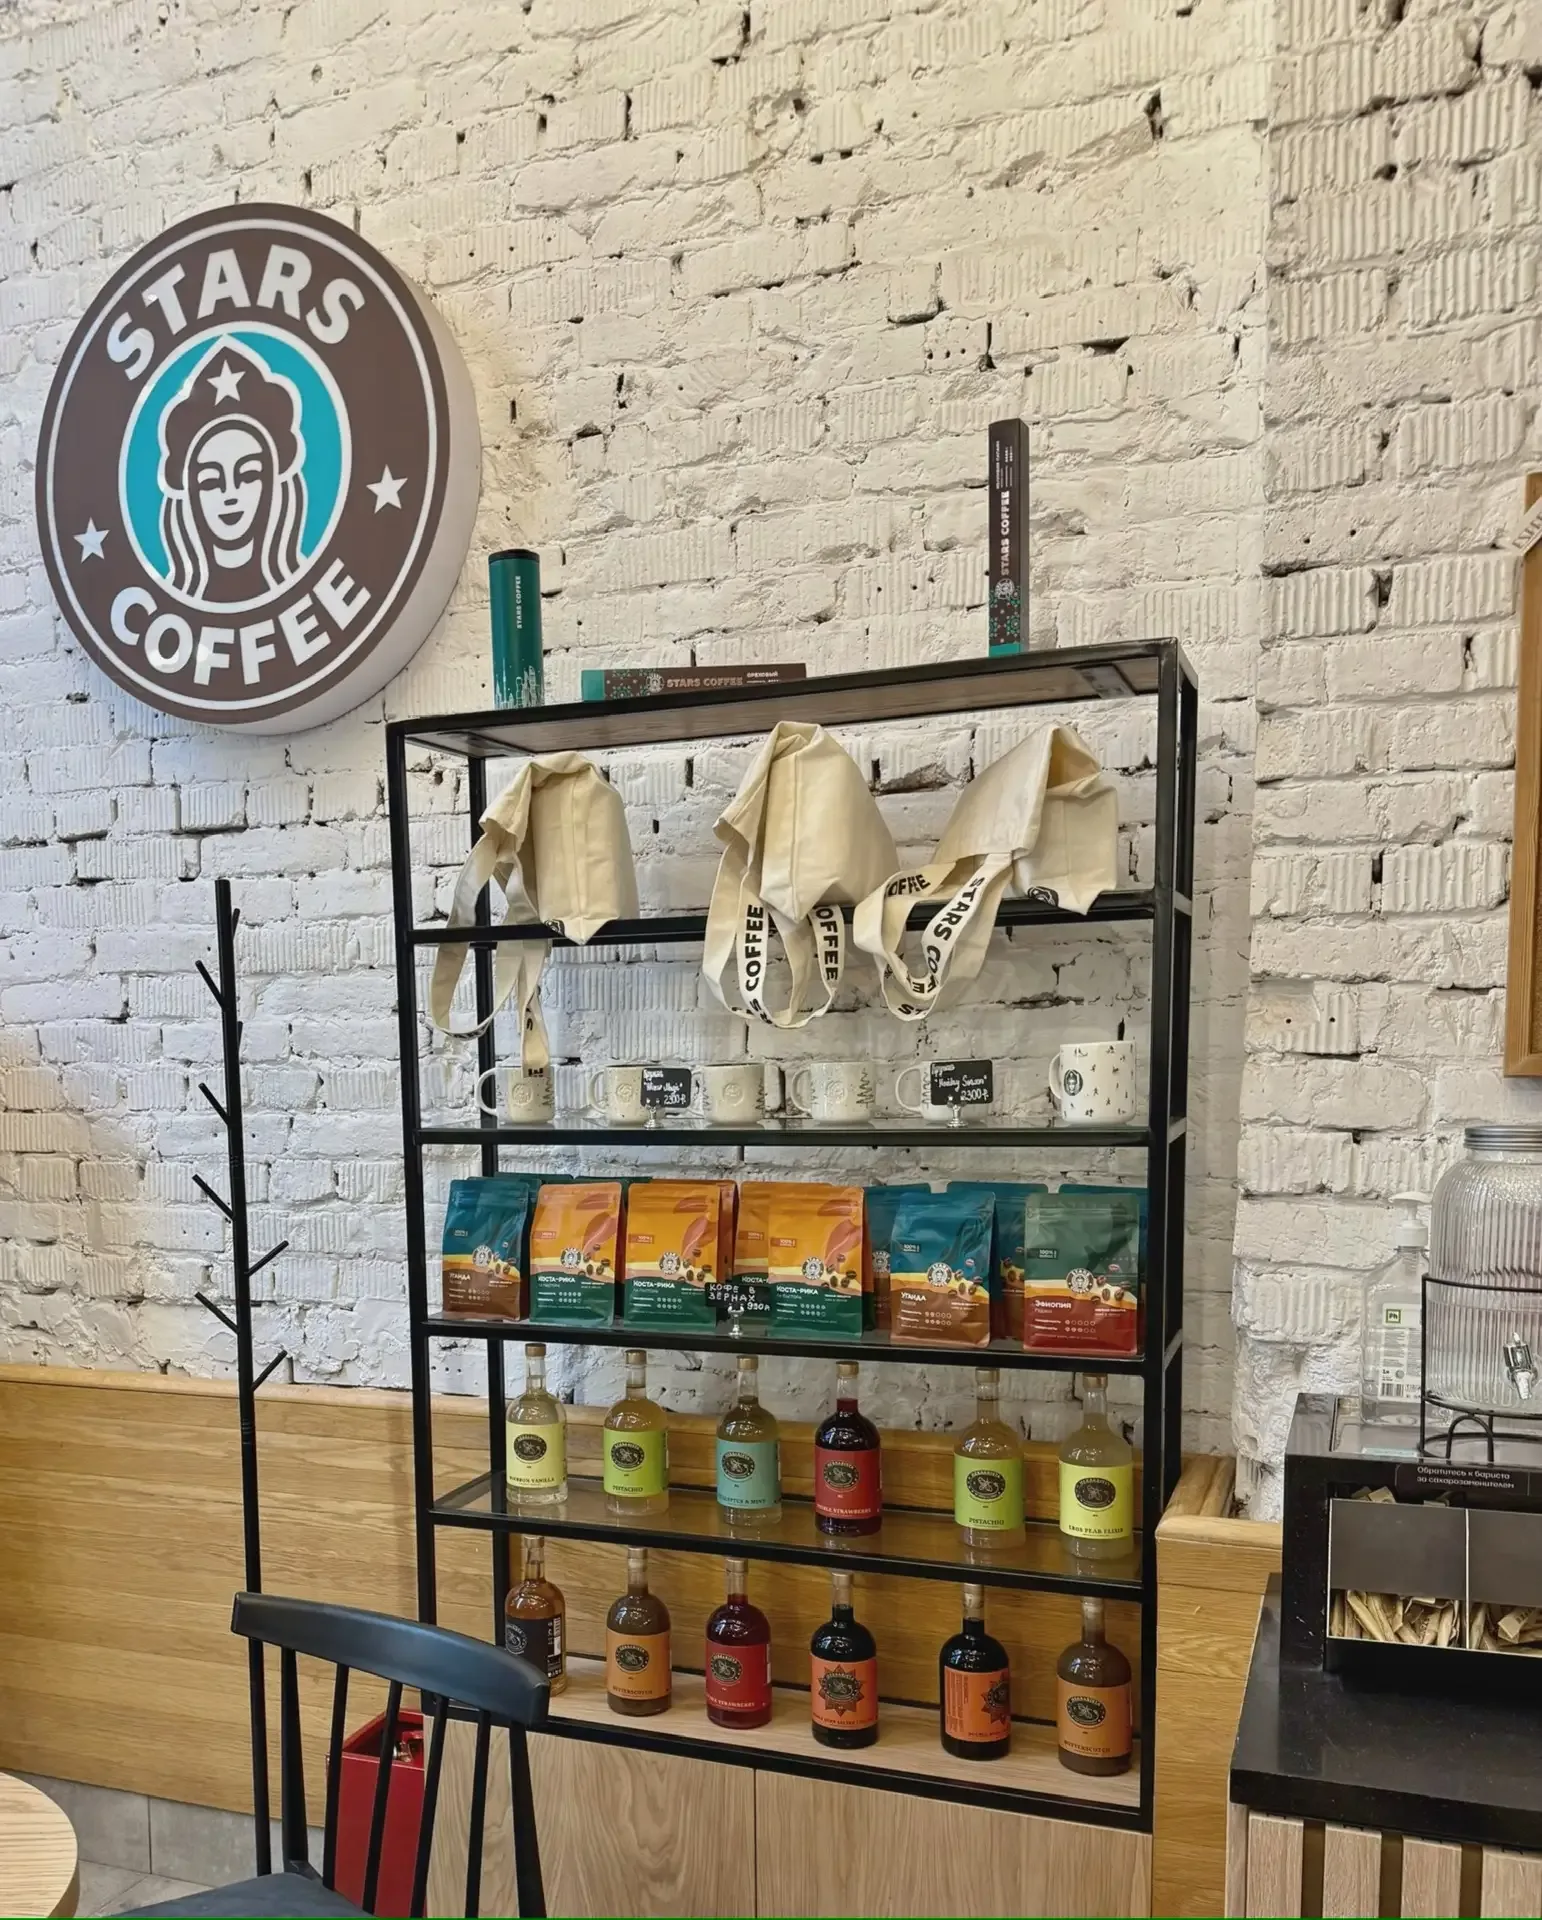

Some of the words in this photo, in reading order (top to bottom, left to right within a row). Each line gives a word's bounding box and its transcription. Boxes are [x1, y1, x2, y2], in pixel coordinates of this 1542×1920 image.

[107, 245, 365, 381] STARS
[1000, 490, 1010, 535] COFFEE
[1000, 538, 1010, 576] STARS
[110, 557, 372, 686] COFFEE
[666, 677, 701, 688] STARS
[703, 675, 744, 687] COFFEE
[933, 876, 985, 942] STARS
[744, 904, 763, 992] COFFEE
[815, 906, 839, 981] OFFEE
[633, 1280, 676, 1289] КОСТА-РИКА
[709, 1283, 740, 1293] КОФЕ
[776, 1285, 819, 1295] КОСТА-РИКА
[708, 1292, 756, 1302] ЗЕРНАХ
[901, 1291, 927, 1302] УГАНДА
[1417, 1466, 1467, 1477] Обратитесь
[1475, 1470, 1511, 1480] бариста
[530, 1476, 555, 1484] VANILLA
[1428, 1477, 1515, 1489] сахарозаменителем
[968, 1517, 1005, 1526] PISTACHIO
[718, 1699, 755, 1708] STRAWBERRY
